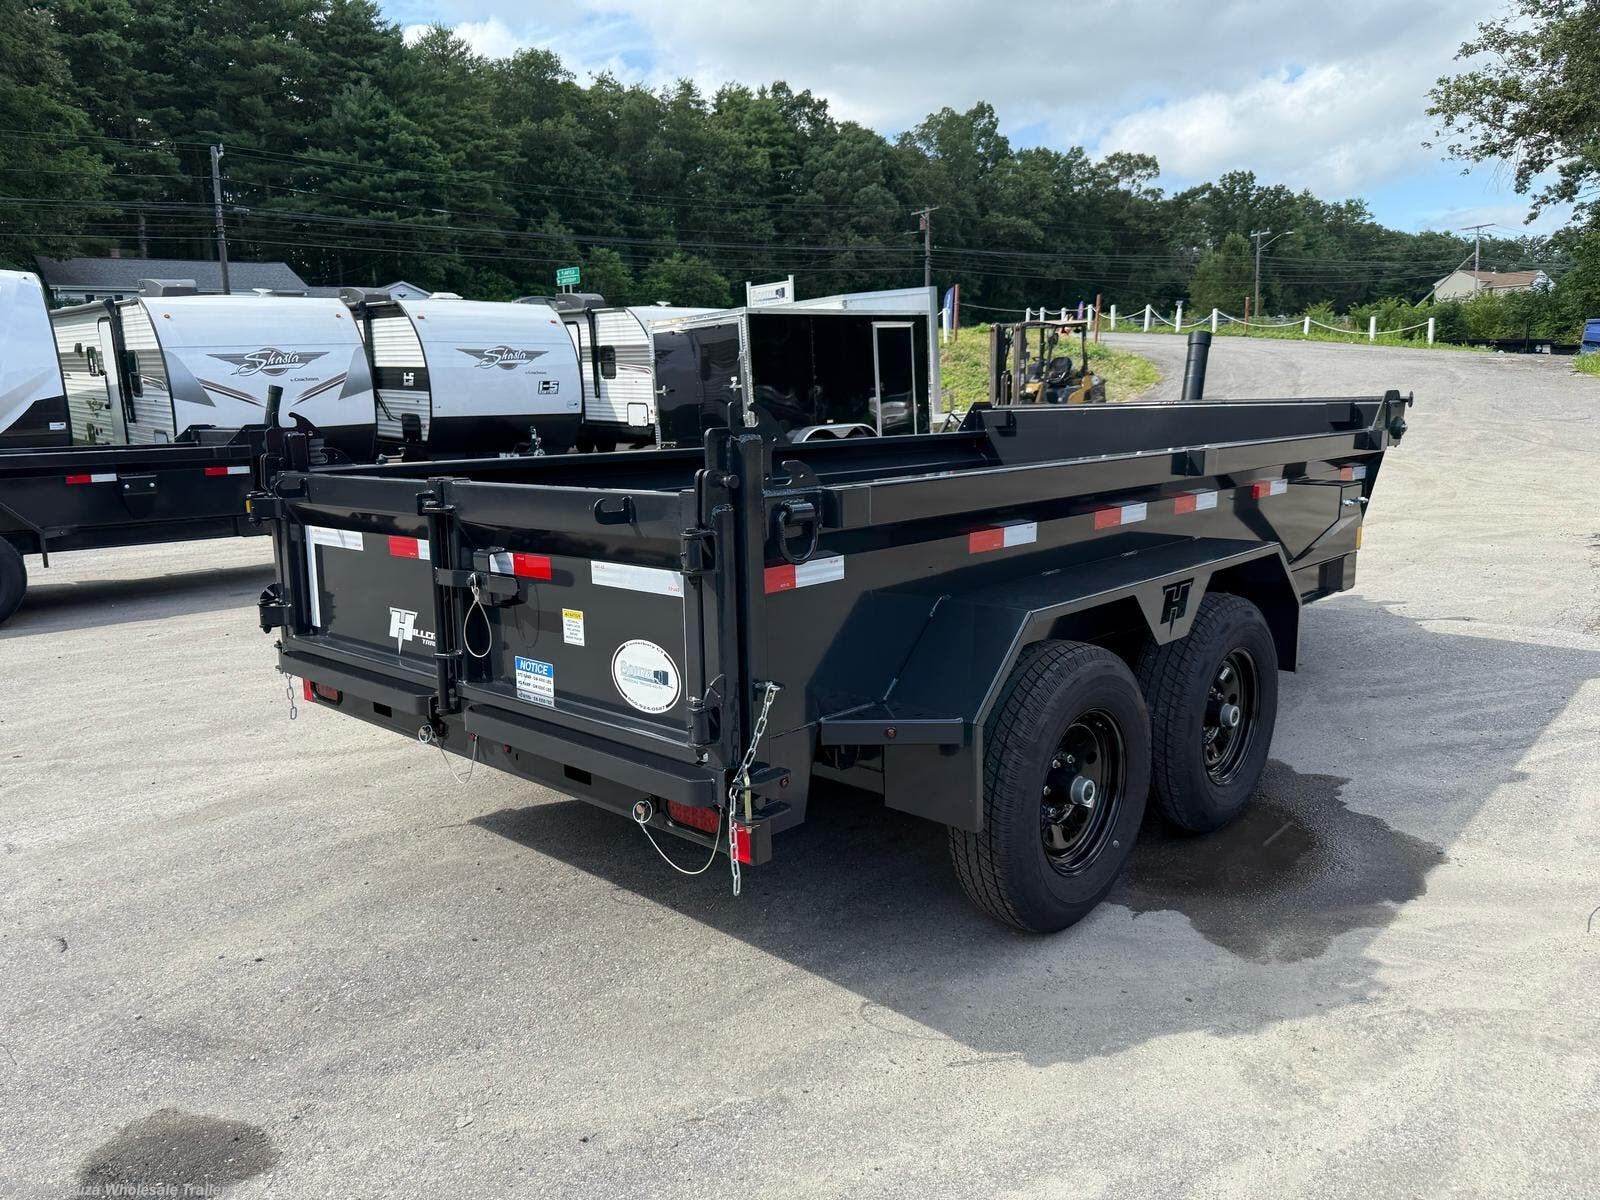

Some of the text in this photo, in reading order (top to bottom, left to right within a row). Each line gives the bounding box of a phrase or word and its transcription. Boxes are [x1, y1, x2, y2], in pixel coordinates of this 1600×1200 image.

[231, 350, 304, 376] Shasta
[475, 347, 533, 369] Shasta
[520, 660, 549, 675] NOTICE
